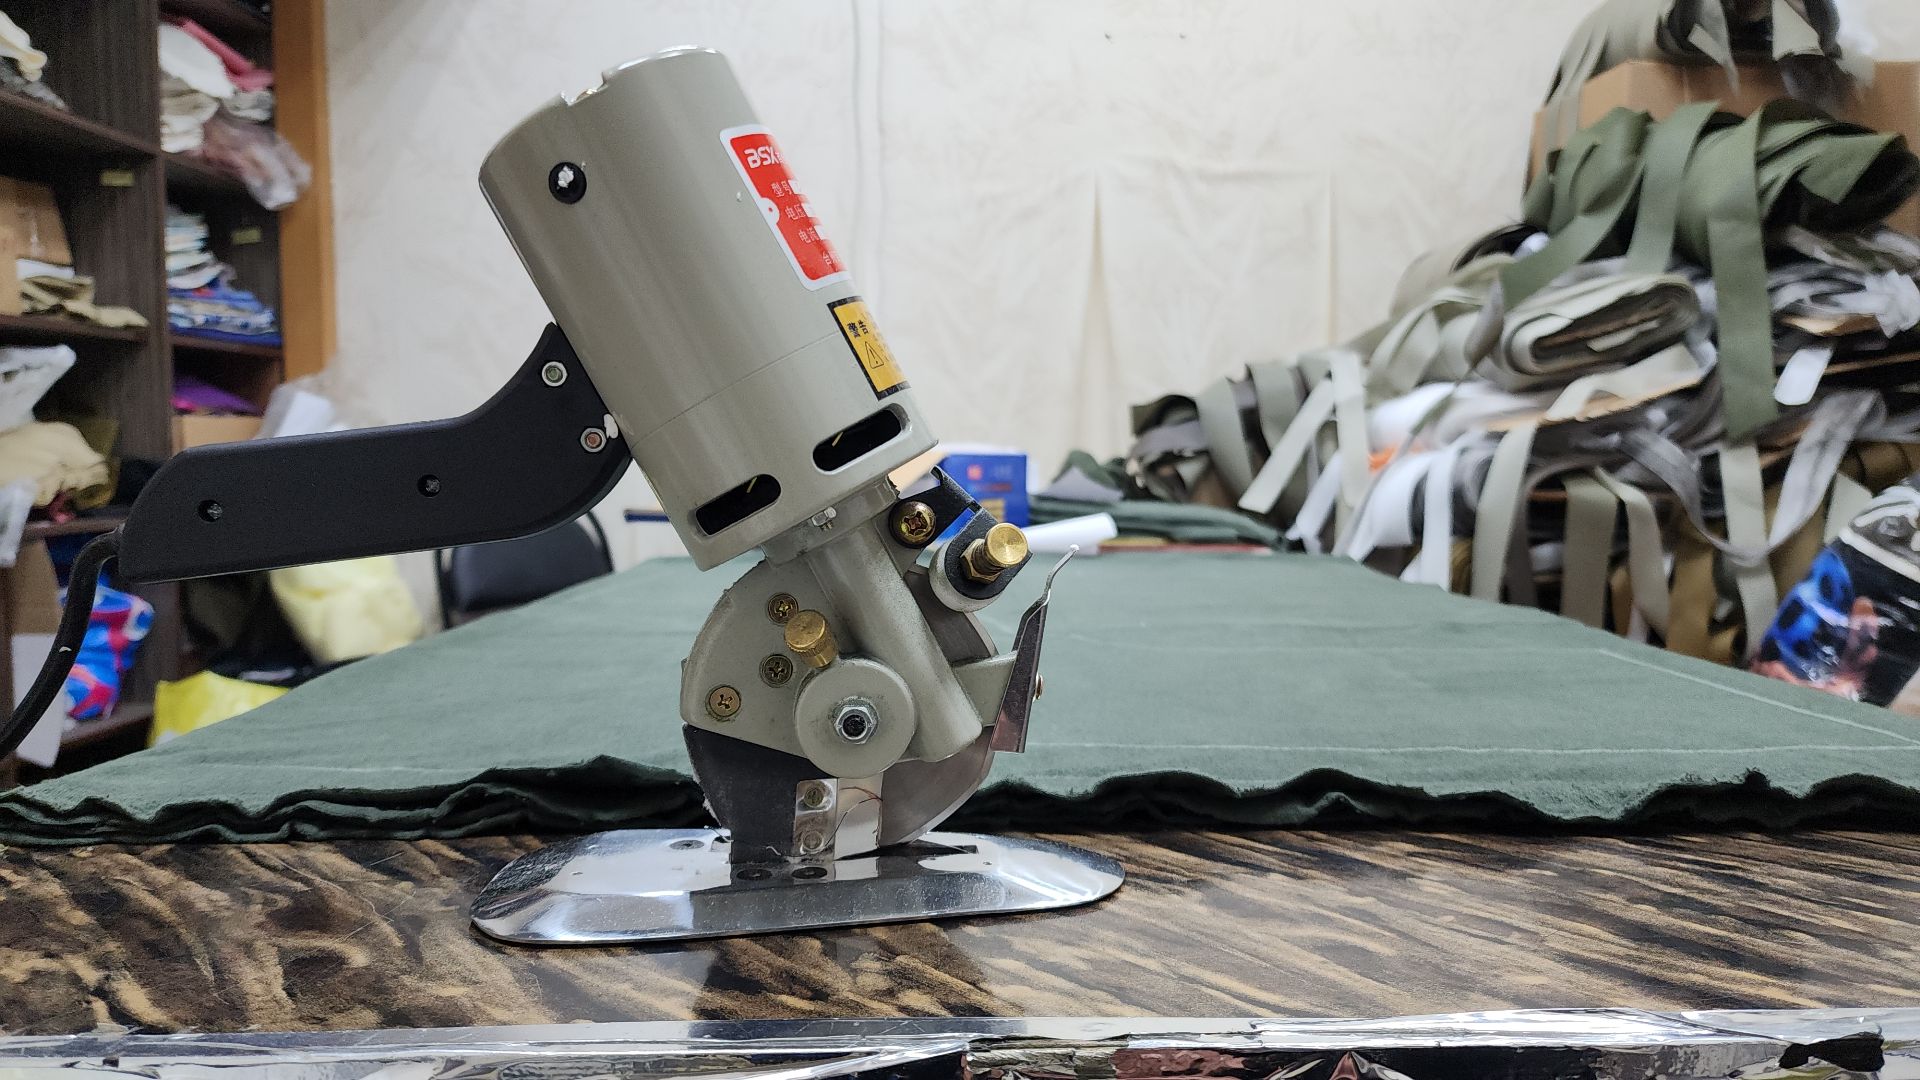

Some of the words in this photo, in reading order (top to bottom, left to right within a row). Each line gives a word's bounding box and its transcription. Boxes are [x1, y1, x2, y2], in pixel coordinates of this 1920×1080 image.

[771, 180, 792, 197] 型号
[785, 204, 806, 220] 电压
[847, 319, 869, 338] 警告
